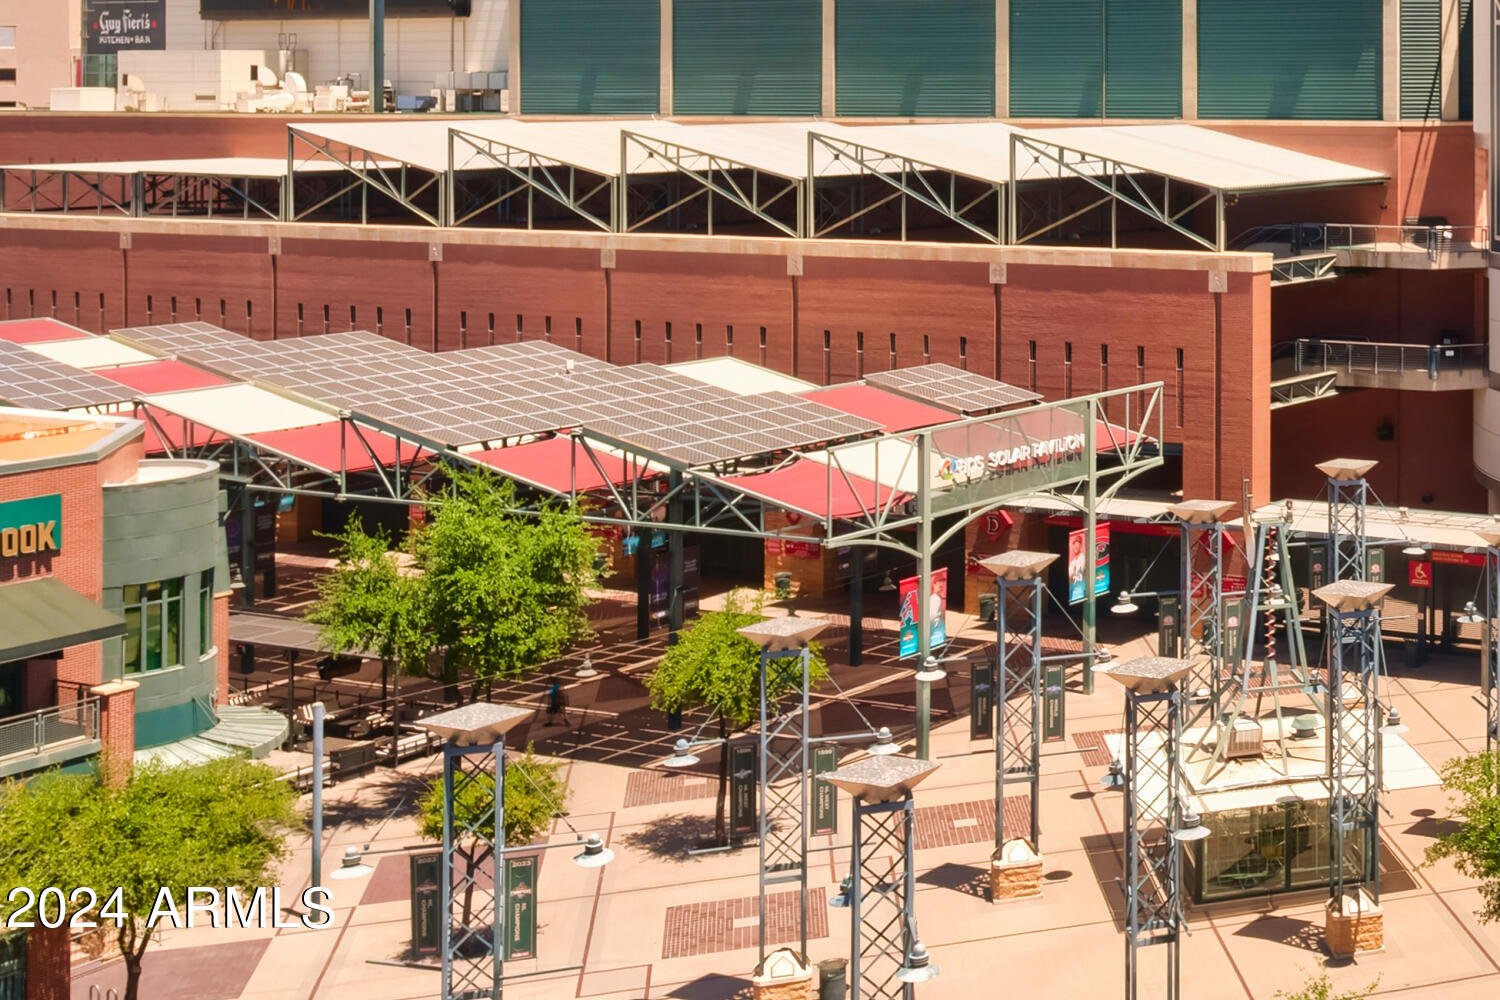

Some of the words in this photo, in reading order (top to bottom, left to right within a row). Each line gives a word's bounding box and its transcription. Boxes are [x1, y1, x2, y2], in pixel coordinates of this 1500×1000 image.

[99, 11, 121, 35] Guy
[99, 36, 130, 45] KITCHEN
[134, 35, 152, 44] BAR
[988, 445, 1031, 468] SOLAR
[1031, 433, 1085, 457] PAVILION
